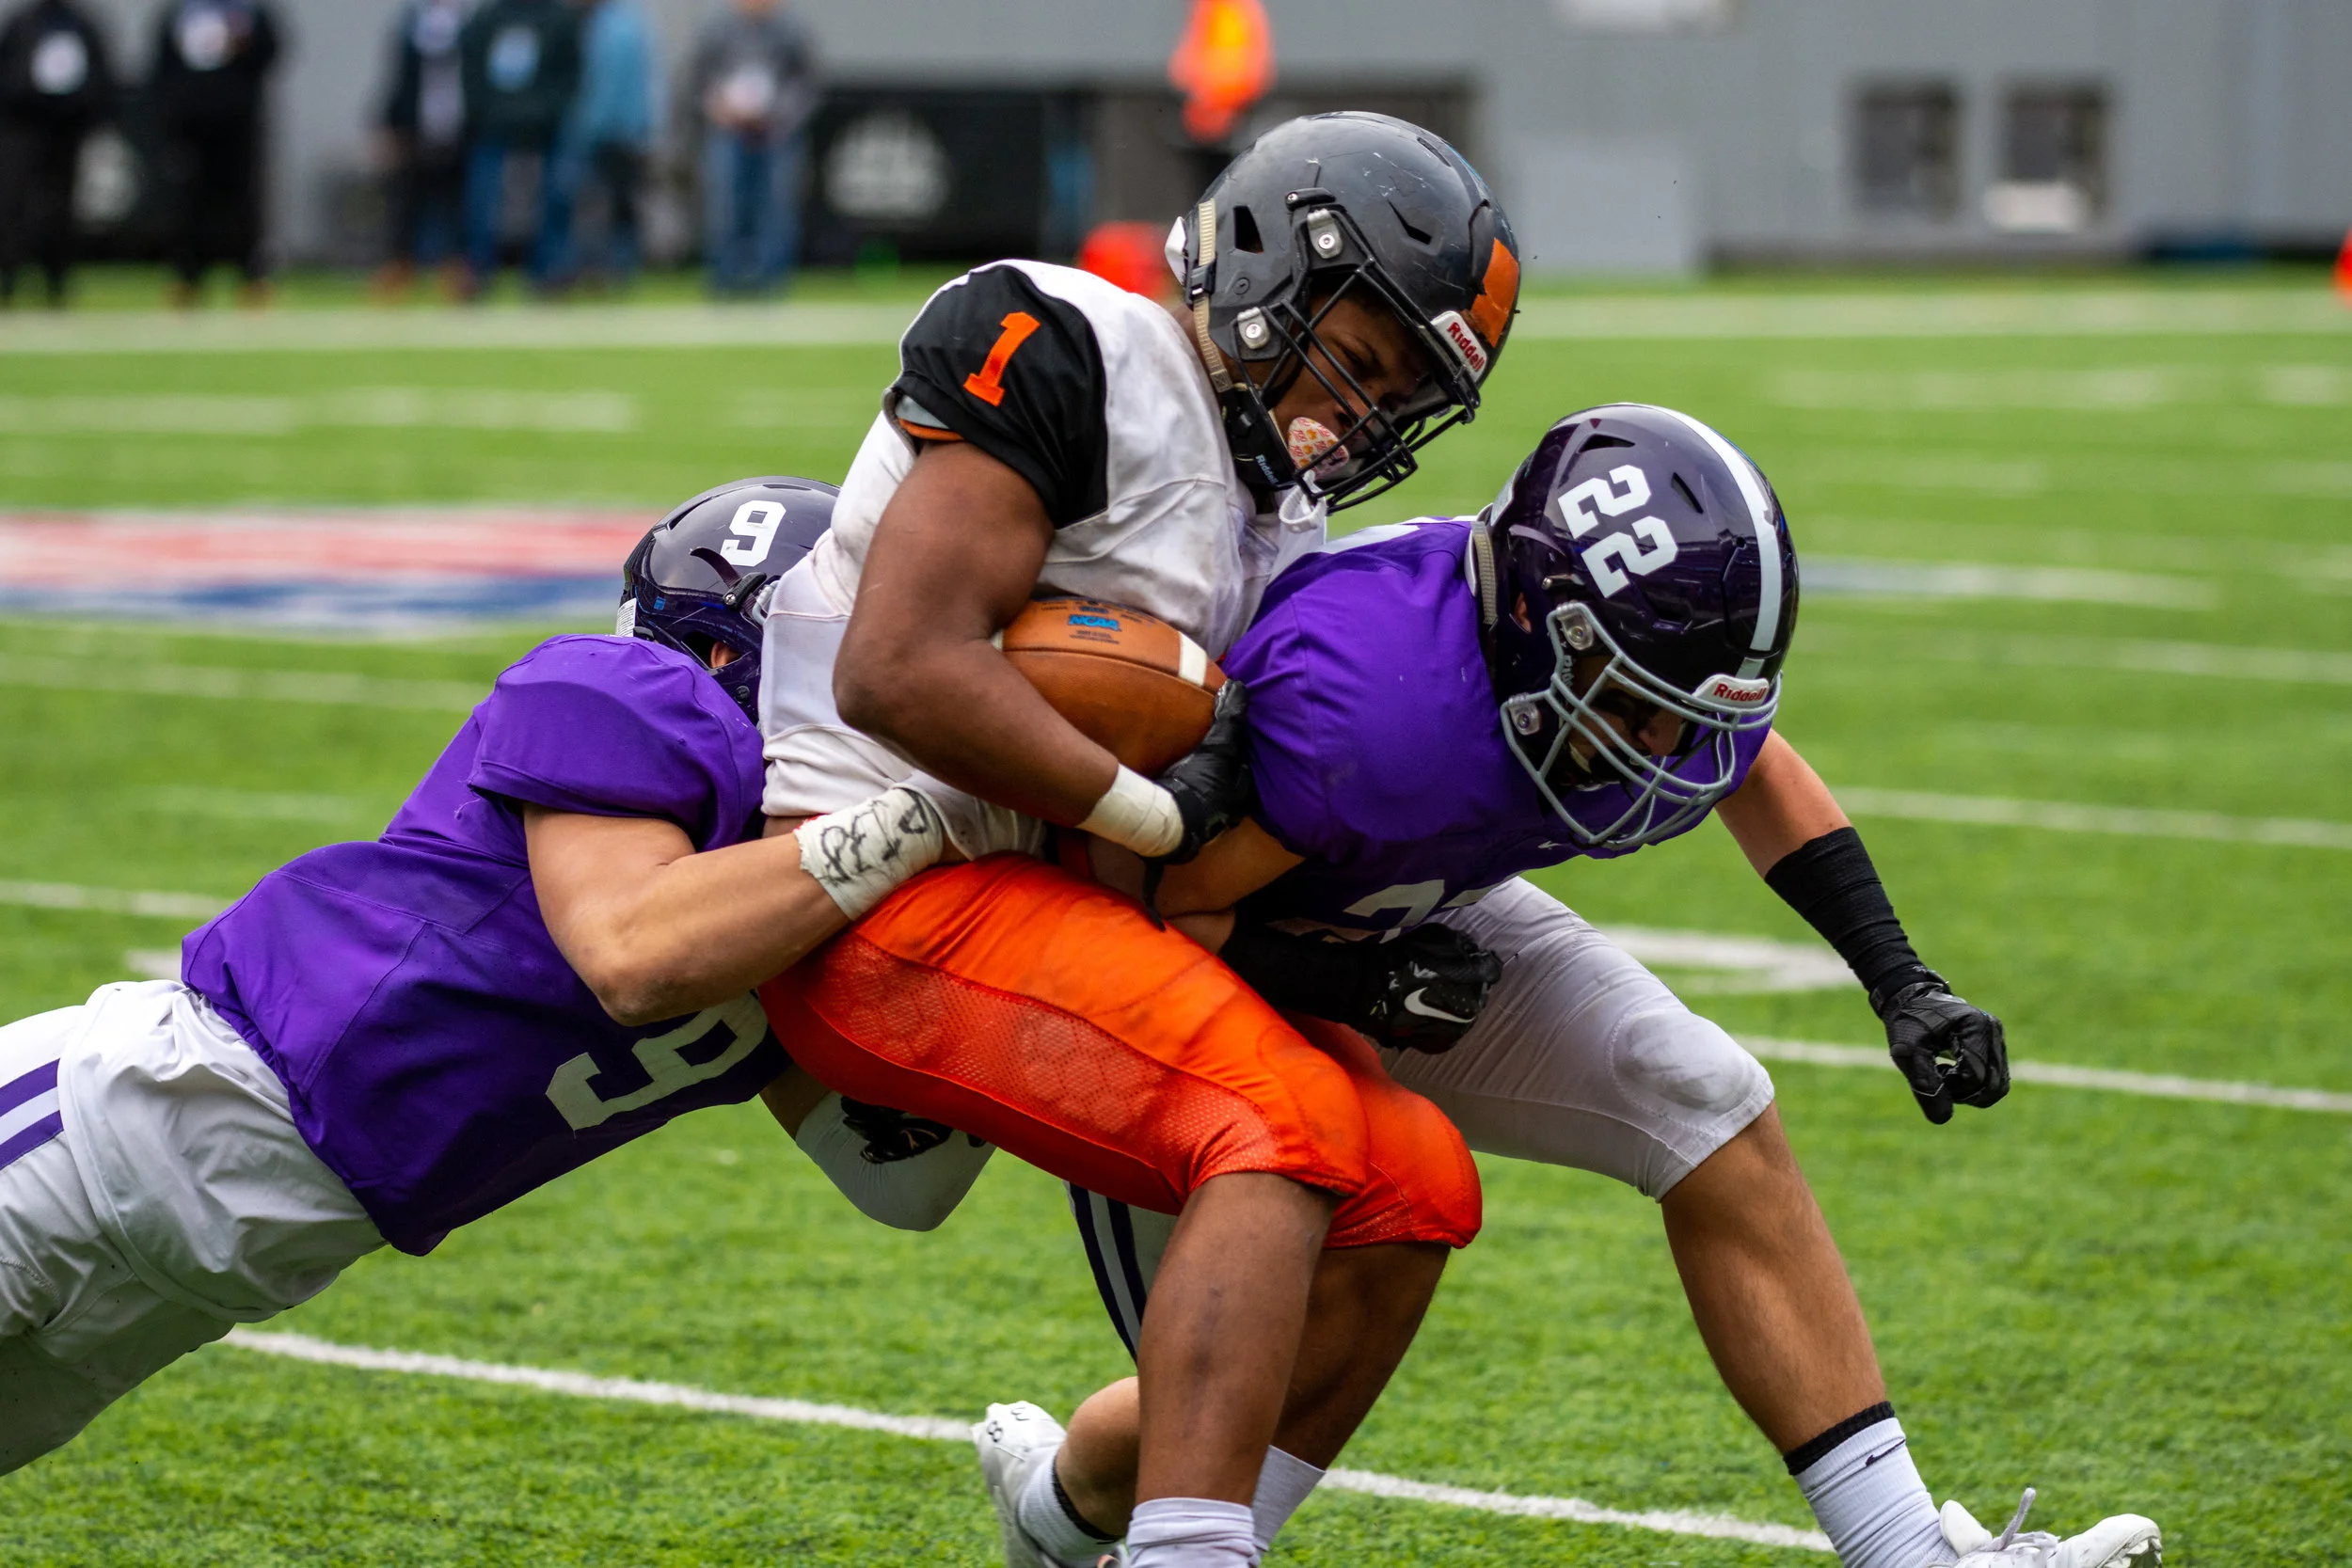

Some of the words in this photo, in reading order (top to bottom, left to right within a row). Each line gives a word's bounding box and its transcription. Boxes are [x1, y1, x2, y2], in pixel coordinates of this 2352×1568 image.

[962, 311, 1041, 406] 1
[1447, 322, 1485, 372] Riddell
[720, 499, 787, 567] 9
[1557, 465, 1679, 598] 22
[1713, 683, 1768, 702] Riddell
[546, 989, 768, 1131] 9
